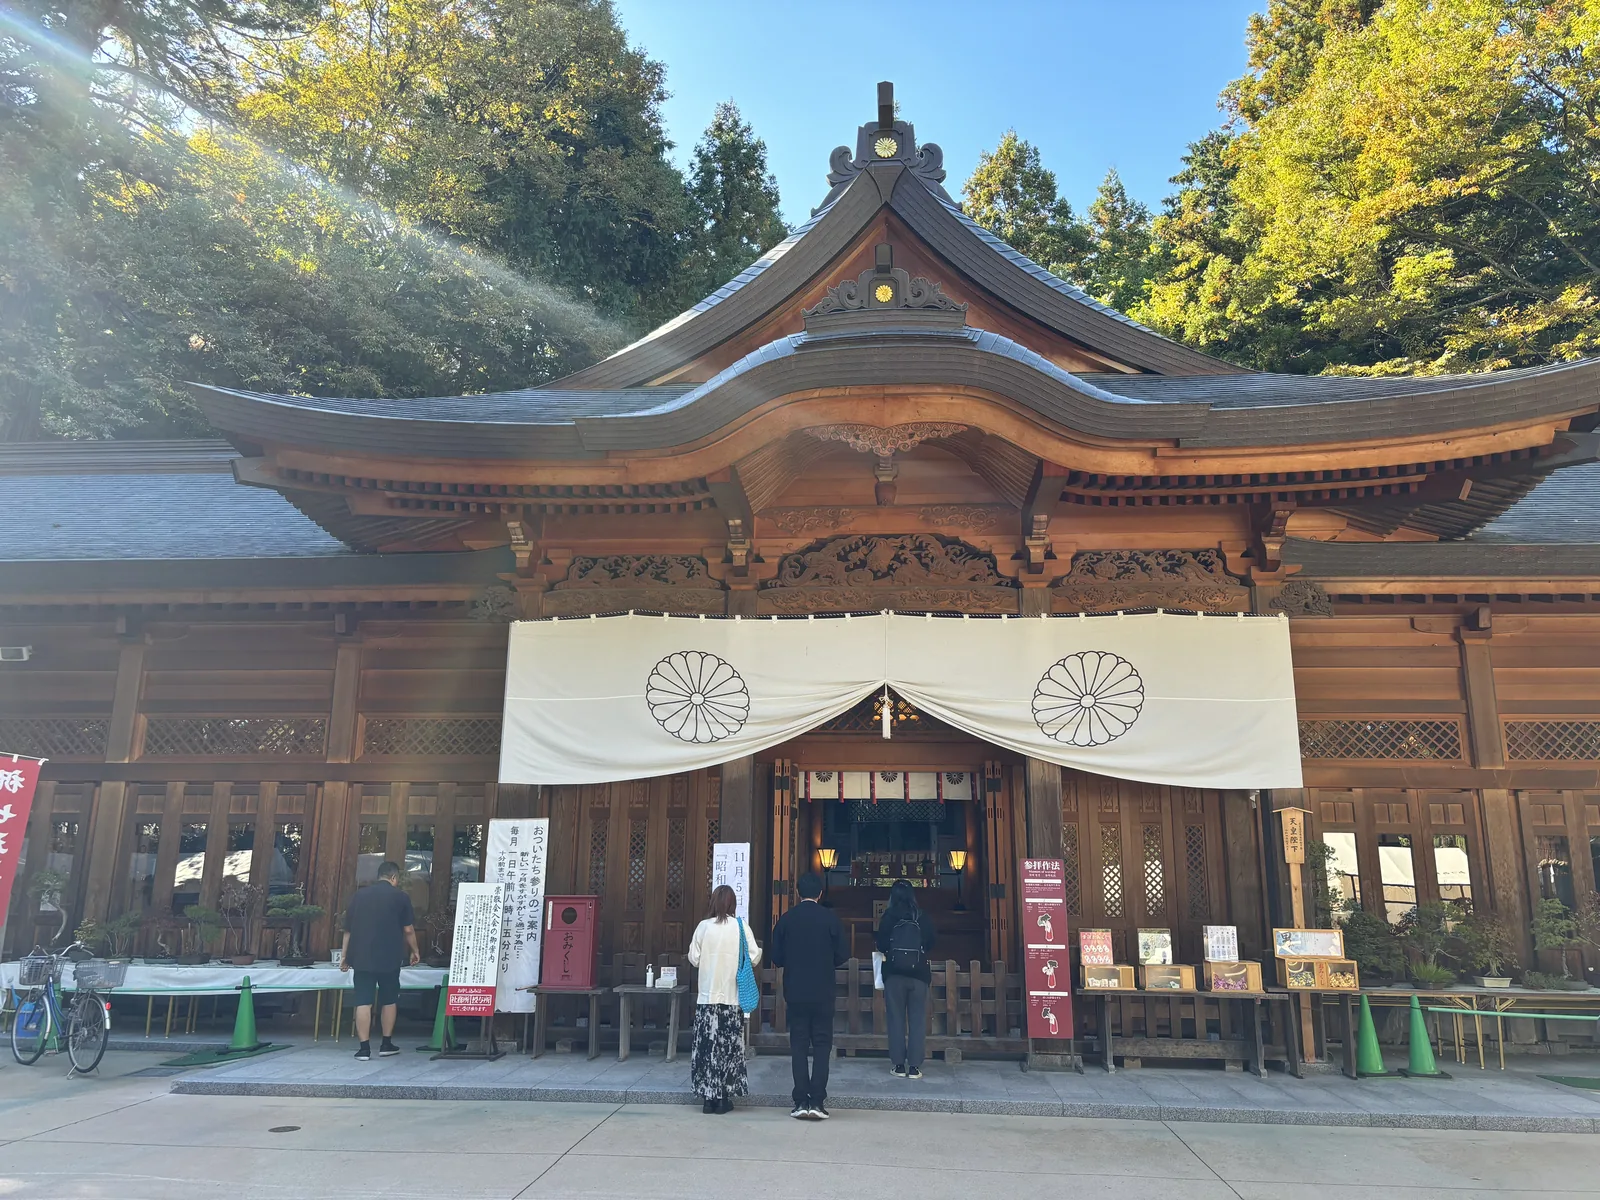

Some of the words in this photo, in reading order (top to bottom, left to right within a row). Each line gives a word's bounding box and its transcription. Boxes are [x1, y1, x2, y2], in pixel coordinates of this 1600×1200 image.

[1024, 860, 1060, 870] 参拝作法
[1289, 817, 1298, 853] 天皇陛下
[501, 826, 519, 973] 毎月一日午前八時十五分より
[526, 826, 544, 942] おついたち参りのご案内
